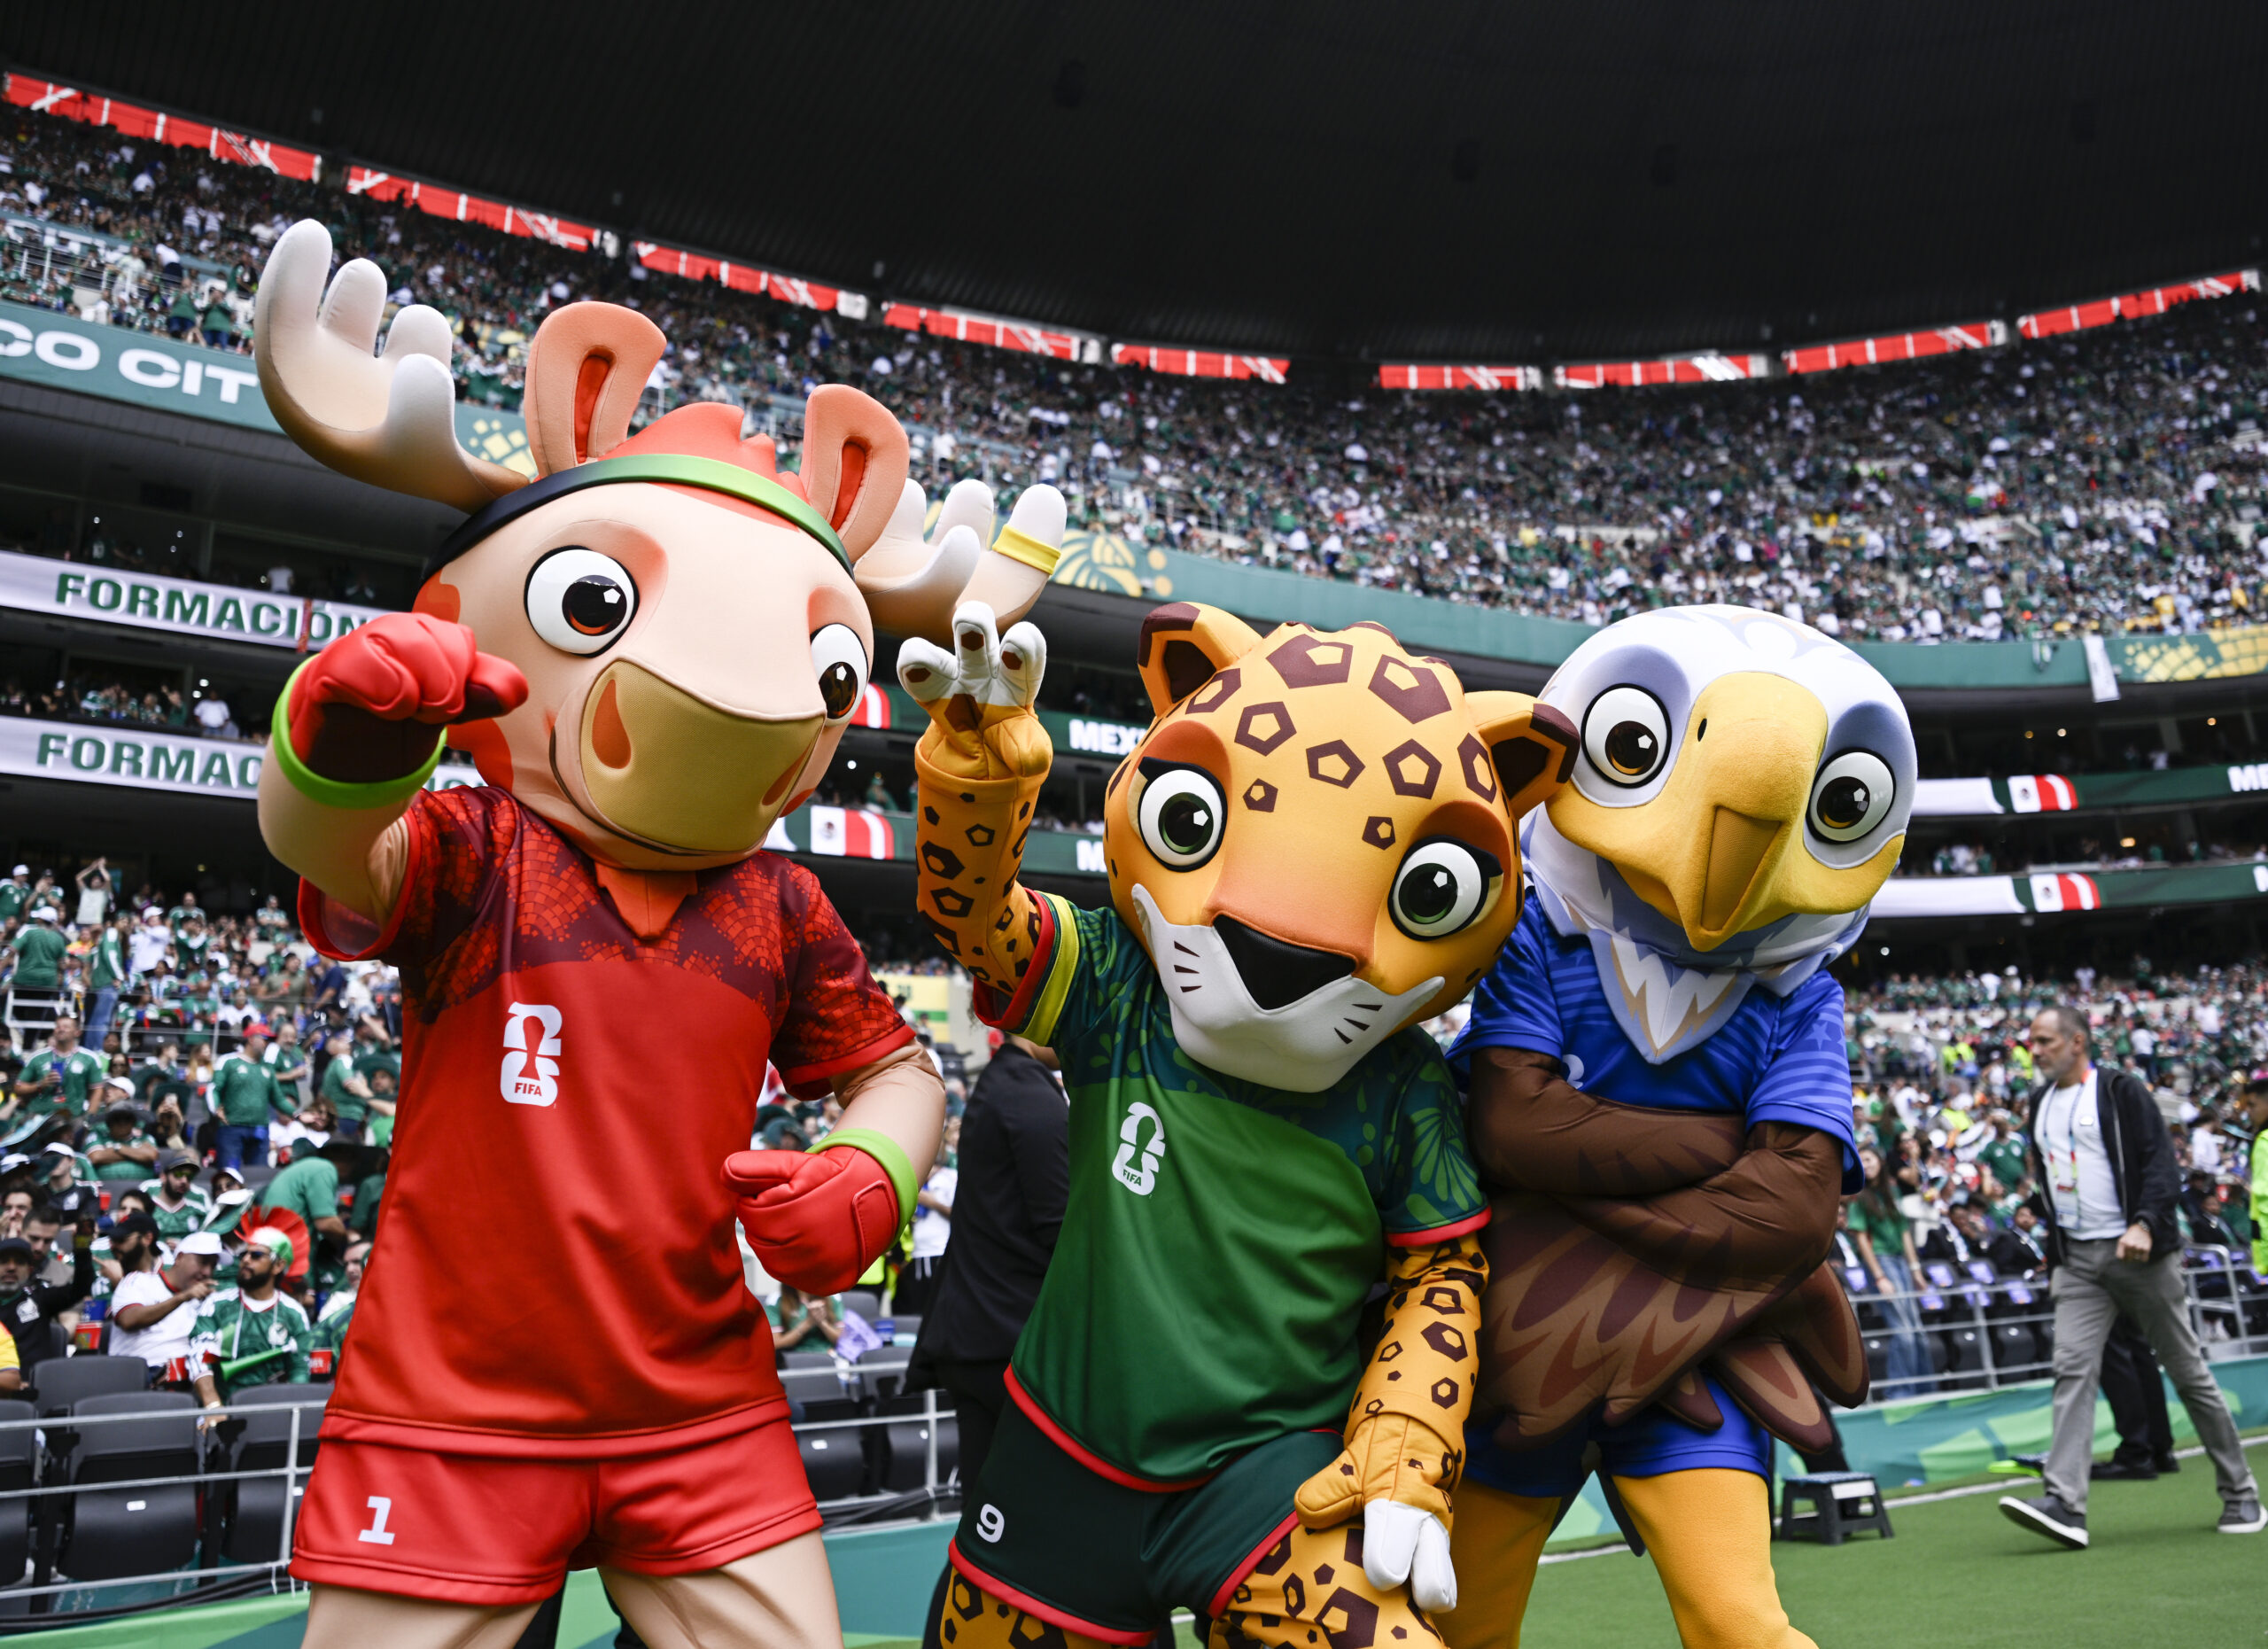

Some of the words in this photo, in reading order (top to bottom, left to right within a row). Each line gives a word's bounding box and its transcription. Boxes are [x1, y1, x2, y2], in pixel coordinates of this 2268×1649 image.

[514, 1082, 543, 1097] FIFA
[1122, 1169, 1142, 1186] FIFA
[358, 1495, 396, 1546] 1
[976, 1503, 1005, 1544] 9
